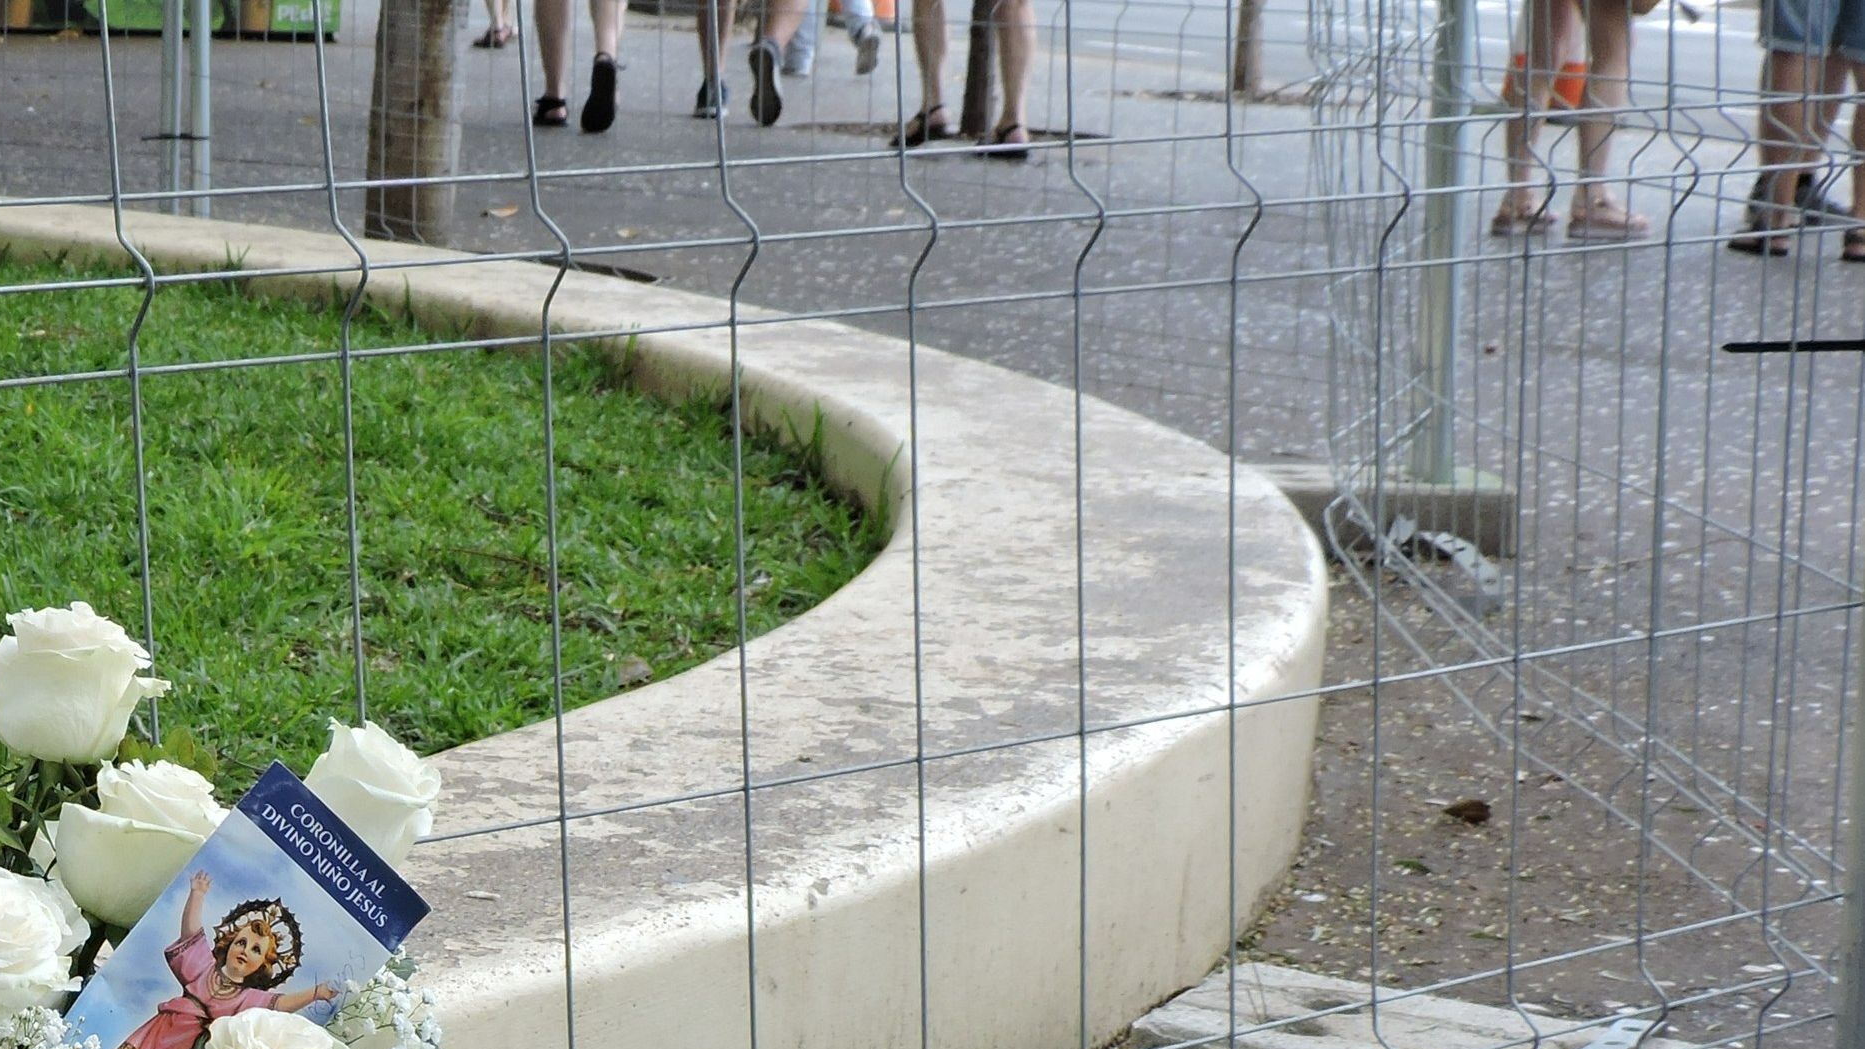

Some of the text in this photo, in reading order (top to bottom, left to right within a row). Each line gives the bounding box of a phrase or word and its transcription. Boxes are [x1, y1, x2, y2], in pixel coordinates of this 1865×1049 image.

[261, 803, 389, 927] DIVINO NIÑO JESÚS
[290, 803, 386, 899] CORONILLA AL
